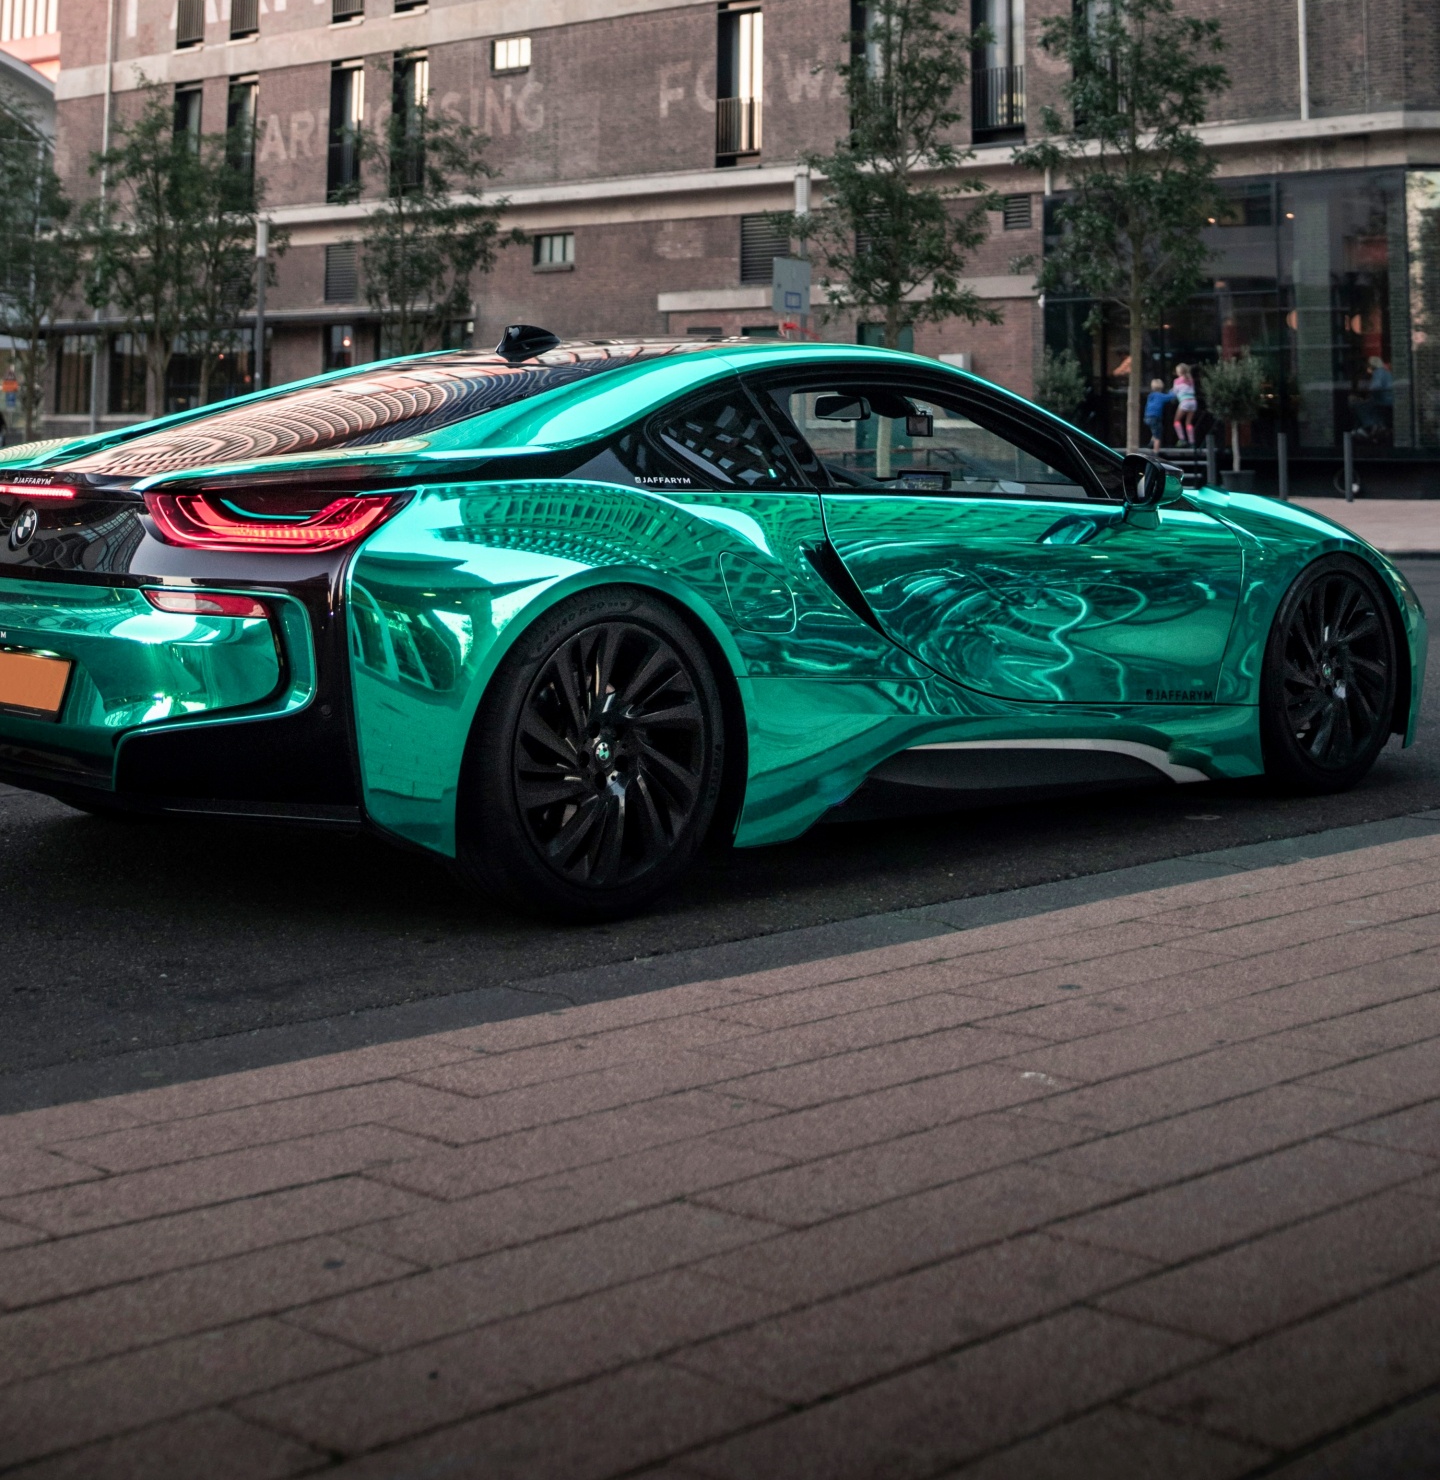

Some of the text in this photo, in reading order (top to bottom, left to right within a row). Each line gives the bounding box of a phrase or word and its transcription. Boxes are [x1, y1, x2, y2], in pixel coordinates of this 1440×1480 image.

[17, 477, 52, 485] JAFFARYM
[642, 476, 691, 484] JAFFARYM
[1155, 689, 1213, 701] JAFFARYM
